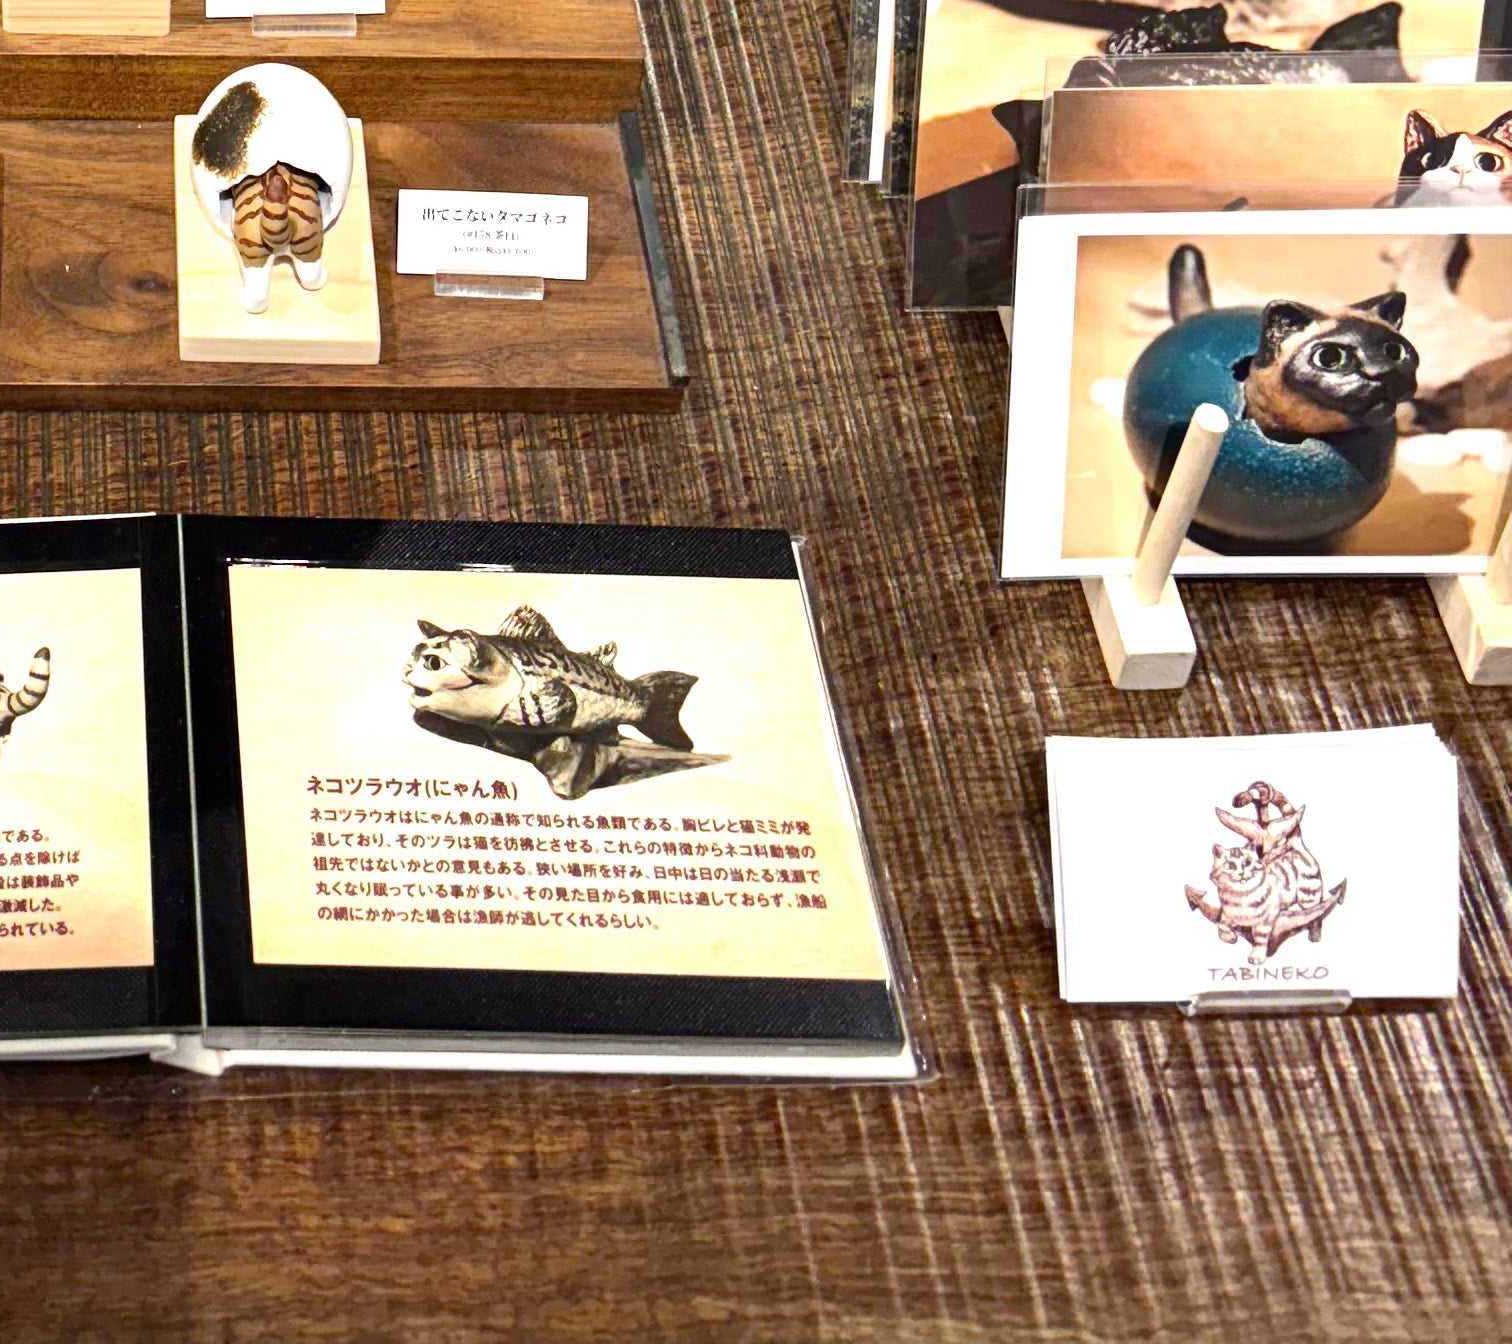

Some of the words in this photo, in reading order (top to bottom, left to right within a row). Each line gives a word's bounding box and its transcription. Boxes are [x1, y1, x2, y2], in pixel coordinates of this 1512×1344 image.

[422, 208, 567, 225] 出てこないタマゴネコ
[307, 776, 518, 800] ネコツラウオ(にゃん魚)
[1207, 965, 1329, 981] TABINEKO
